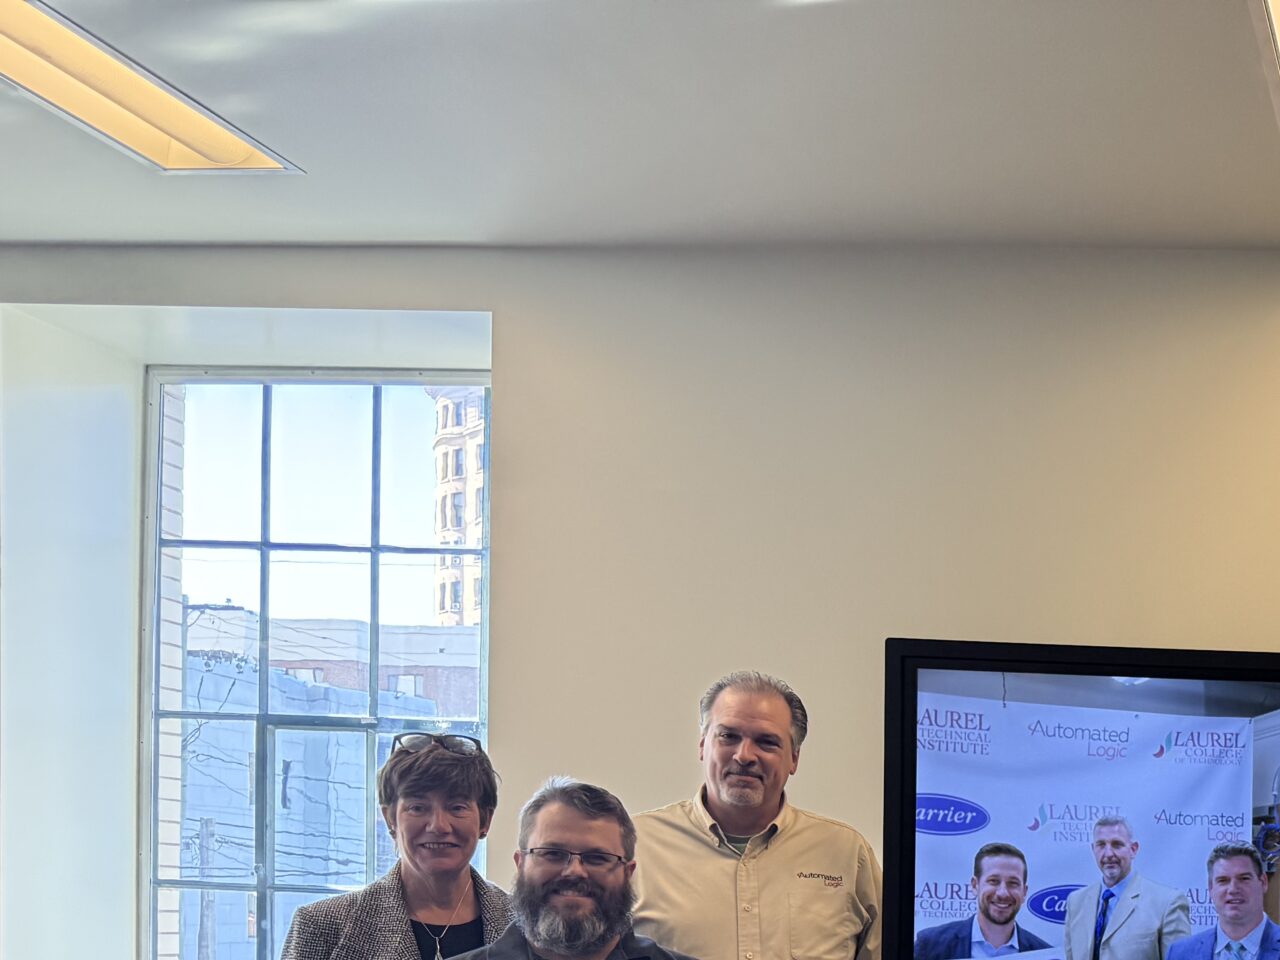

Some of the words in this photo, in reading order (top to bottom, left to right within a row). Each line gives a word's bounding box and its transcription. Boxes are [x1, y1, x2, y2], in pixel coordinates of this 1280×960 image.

[916, 708, 991, 731] AUREL
[919, 727, 991, 743] TECHNICAL
[1028, 720, 1130, 743] Automated
[1174, 731, 1246, 748] LAUREL
[917, 738, 990, 755] NSTITUTE
[1087, 741, 1128, 761] Logic
[1184, 748, 1242, 759] COLLEGE
[916, 806, 977, 824] arrier
[1154, 809, 1245, 828] Automated
[1053, 831, 1090, 842] INSTI
[1207, 827, 1244, 842] Logic
[915, 882, 977, 900] AURE
[920, 900, 977, 911] COLLEG
